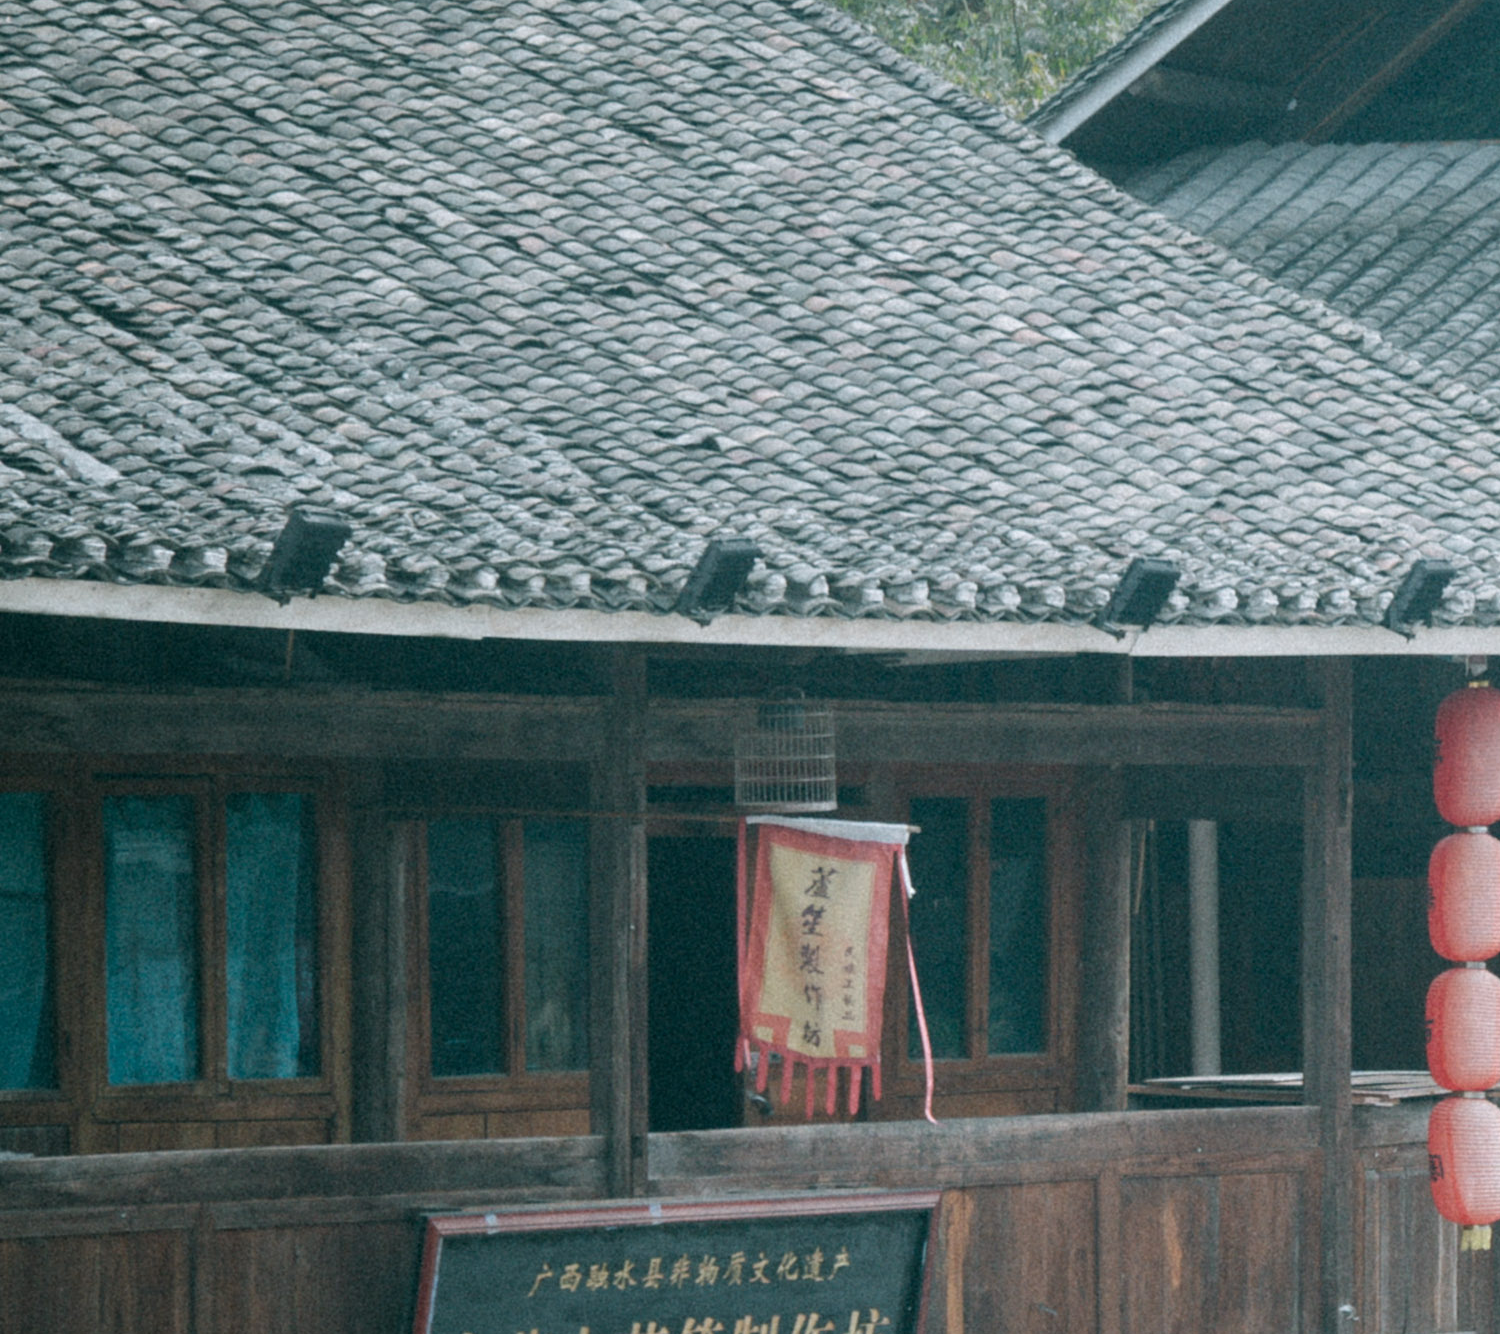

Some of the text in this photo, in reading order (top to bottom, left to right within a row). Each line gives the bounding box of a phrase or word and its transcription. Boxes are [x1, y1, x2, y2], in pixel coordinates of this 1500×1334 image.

[527, 1246, 851, 1297] 广西融水县非物质文化遗产
